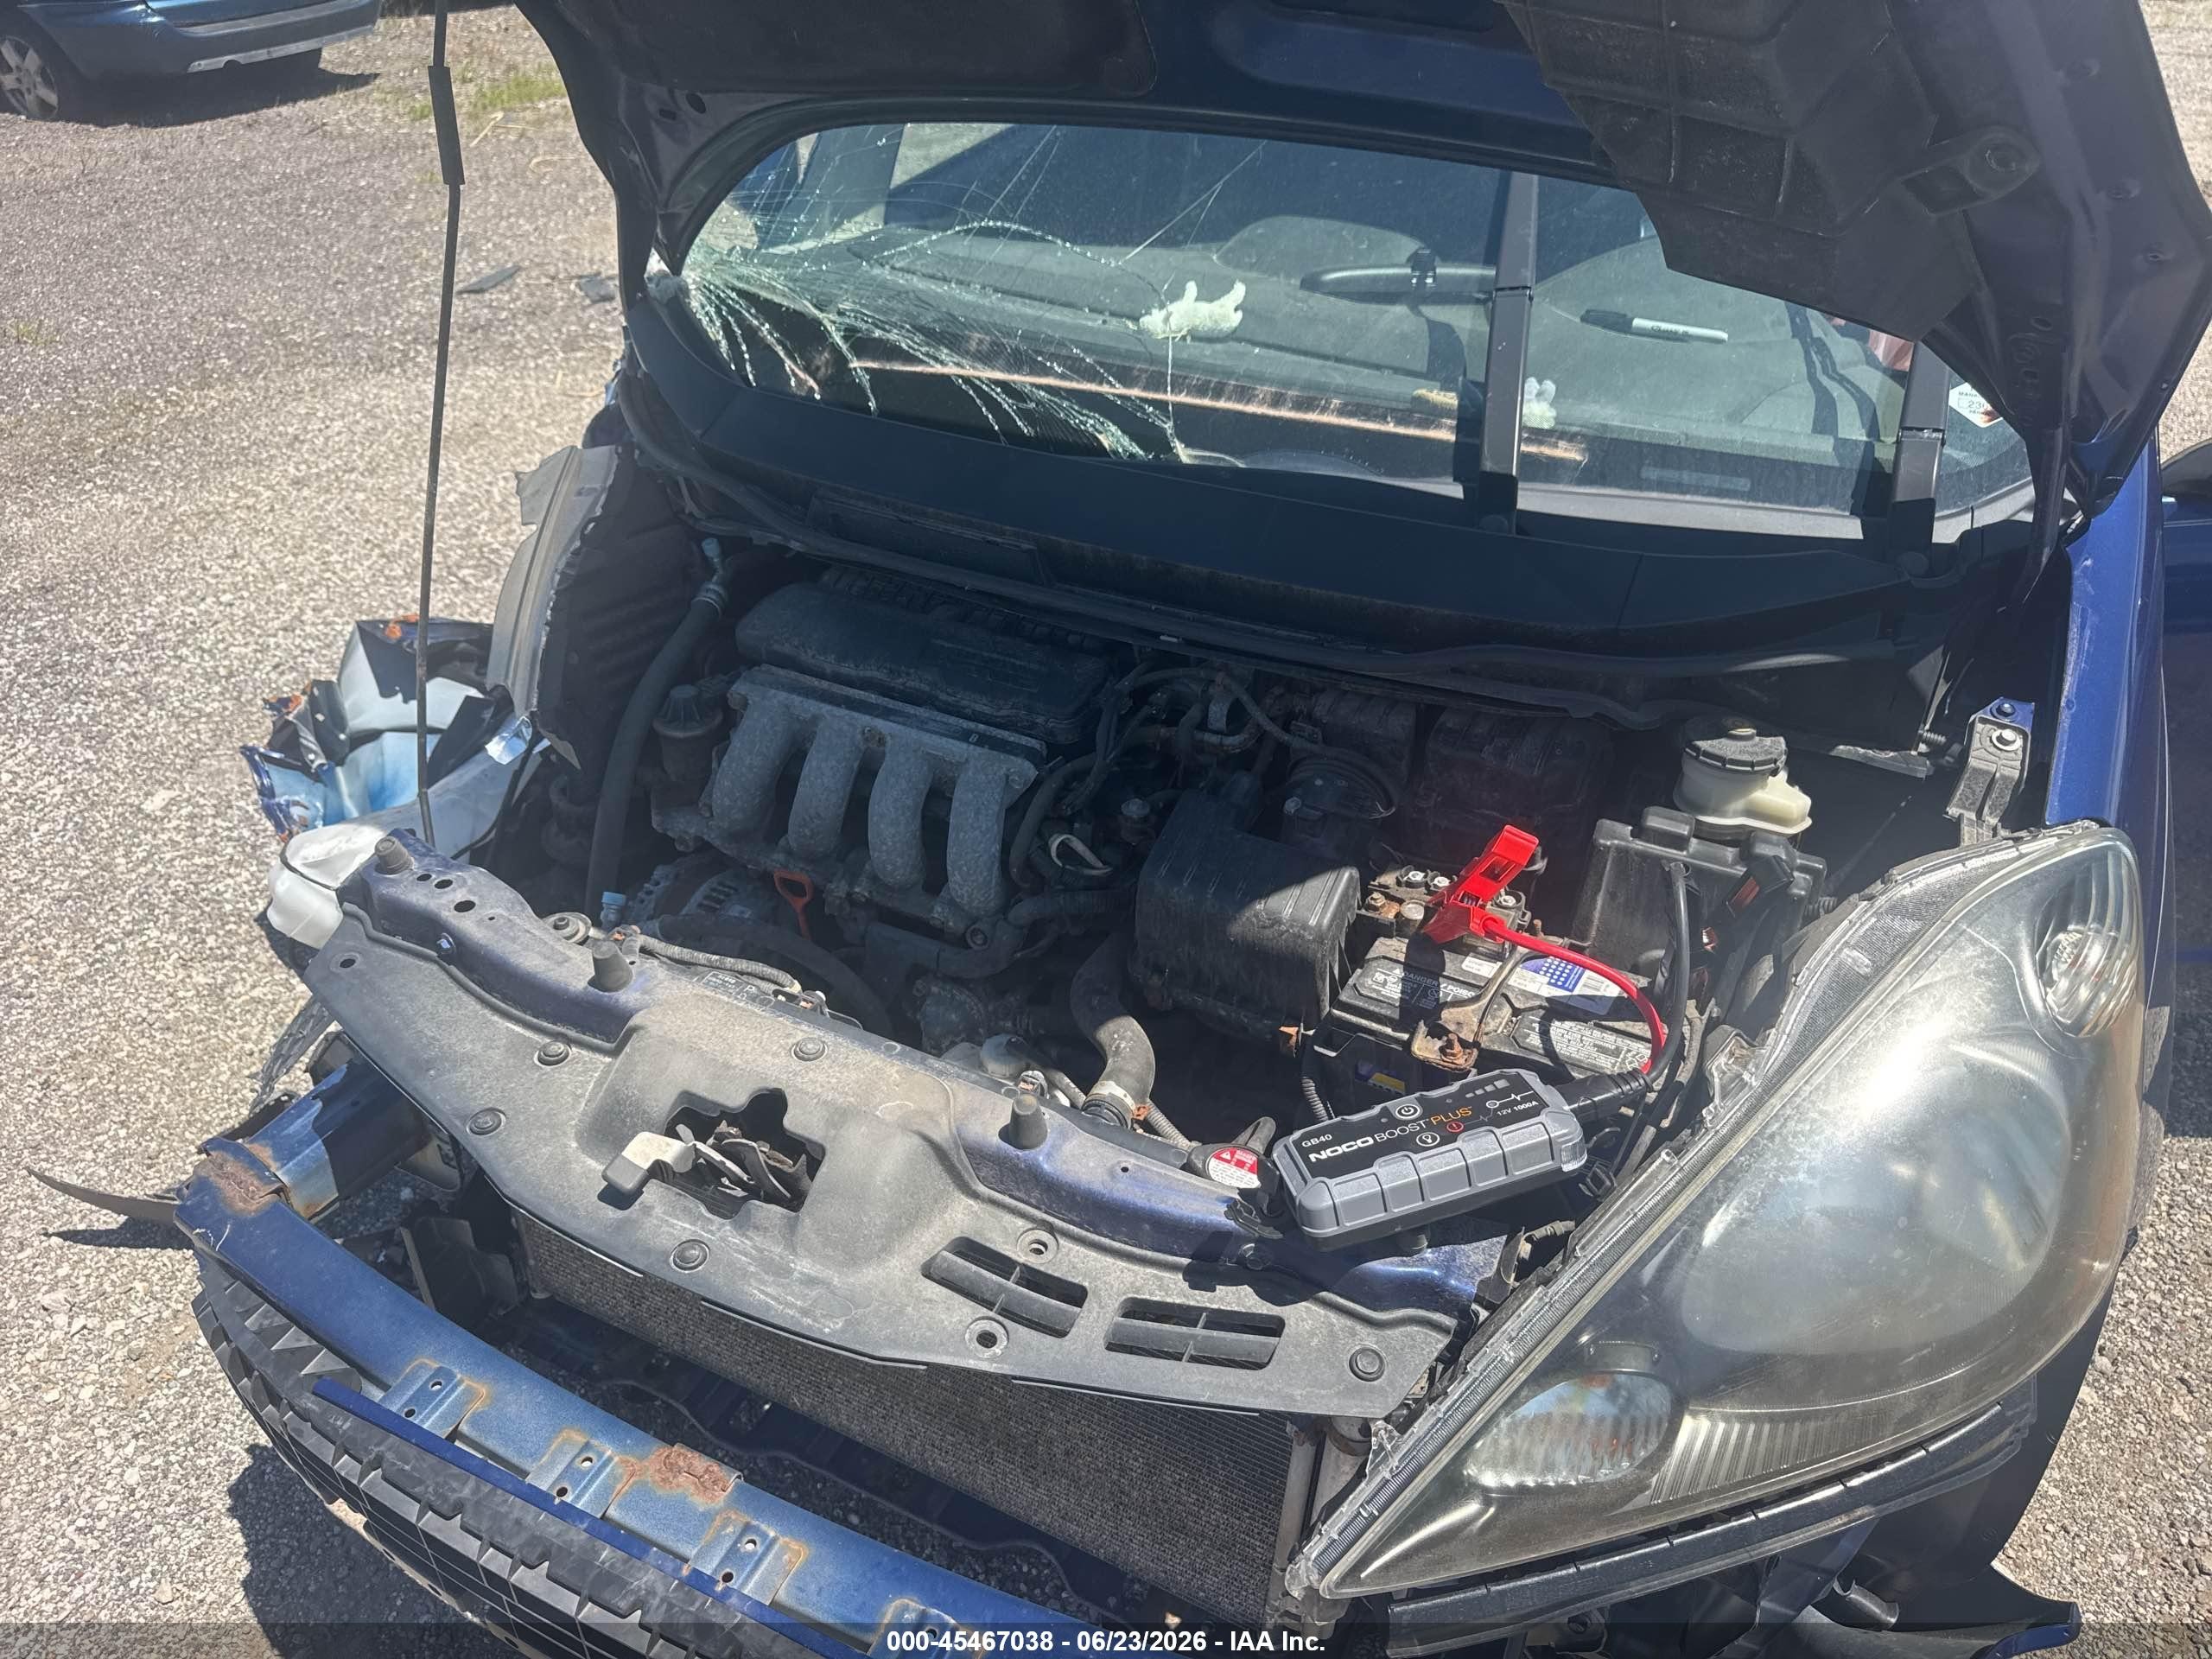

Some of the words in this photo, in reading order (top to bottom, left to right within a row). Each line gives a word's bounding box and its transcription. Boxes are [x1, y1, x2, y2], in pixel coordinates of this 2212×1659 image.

[1446, 985, 1476, 999] POISO
[1513, 1100, 1539, 1111] 1000A
[1301, 1134, 1332, 1147] GB40
[1308, 1136, 1375, 1162] NOCO
[1374, 1120, 1427, 1142] BOOST
[1430, 1106, 1472, 1126] PLUS
